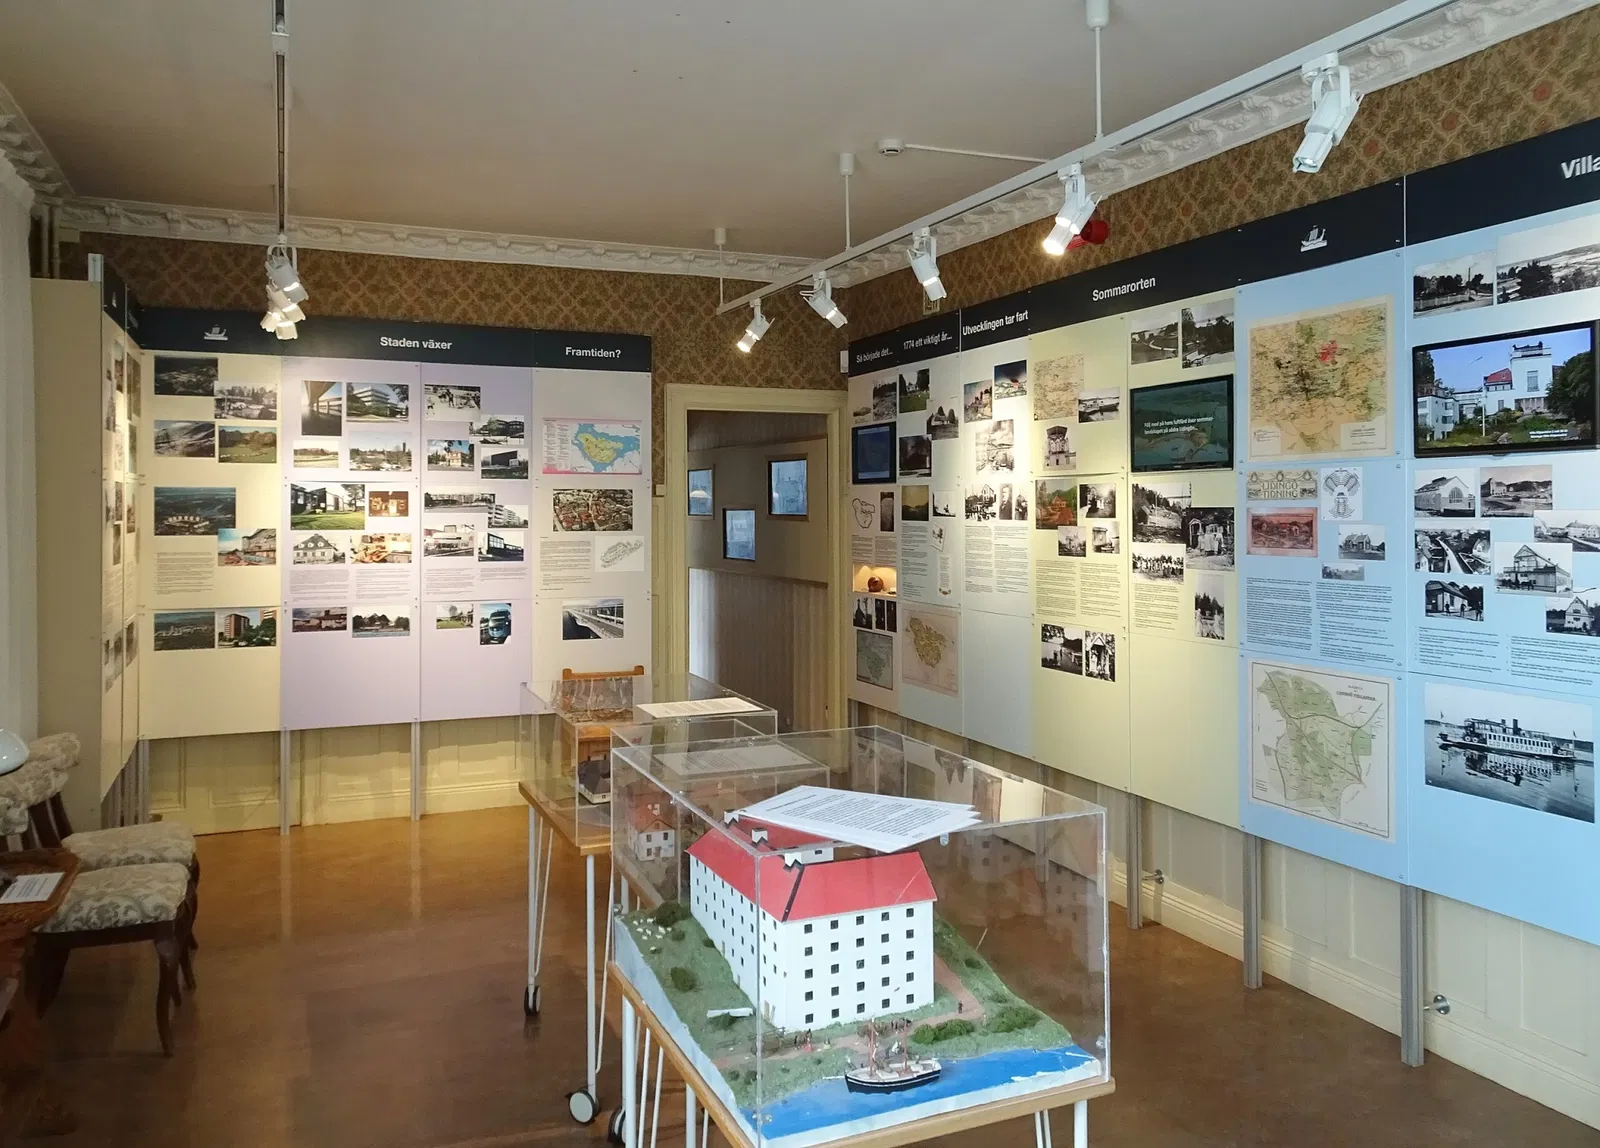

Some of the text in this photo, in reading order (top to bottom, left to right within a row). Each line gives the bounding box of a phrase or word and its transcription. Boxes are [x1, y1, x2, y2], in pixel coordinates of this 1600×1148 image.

[1092, 277, 1156, 301] Sommarorten
[963, 310, 1028, 336] Utvecklingen tar fart
[380, 336, 452, 350] Staden växer
[903, 339, 914, 350] 1774
[915, 337, 923, 348] ett
[923, 333, 940, 347] viktigt
[565, 346, 621, 359] Framtiden?
[856, 353, 863, 364] Så
[863, 349, 881, 363] började
[1261, 490, 1299, 499] TIDNING
